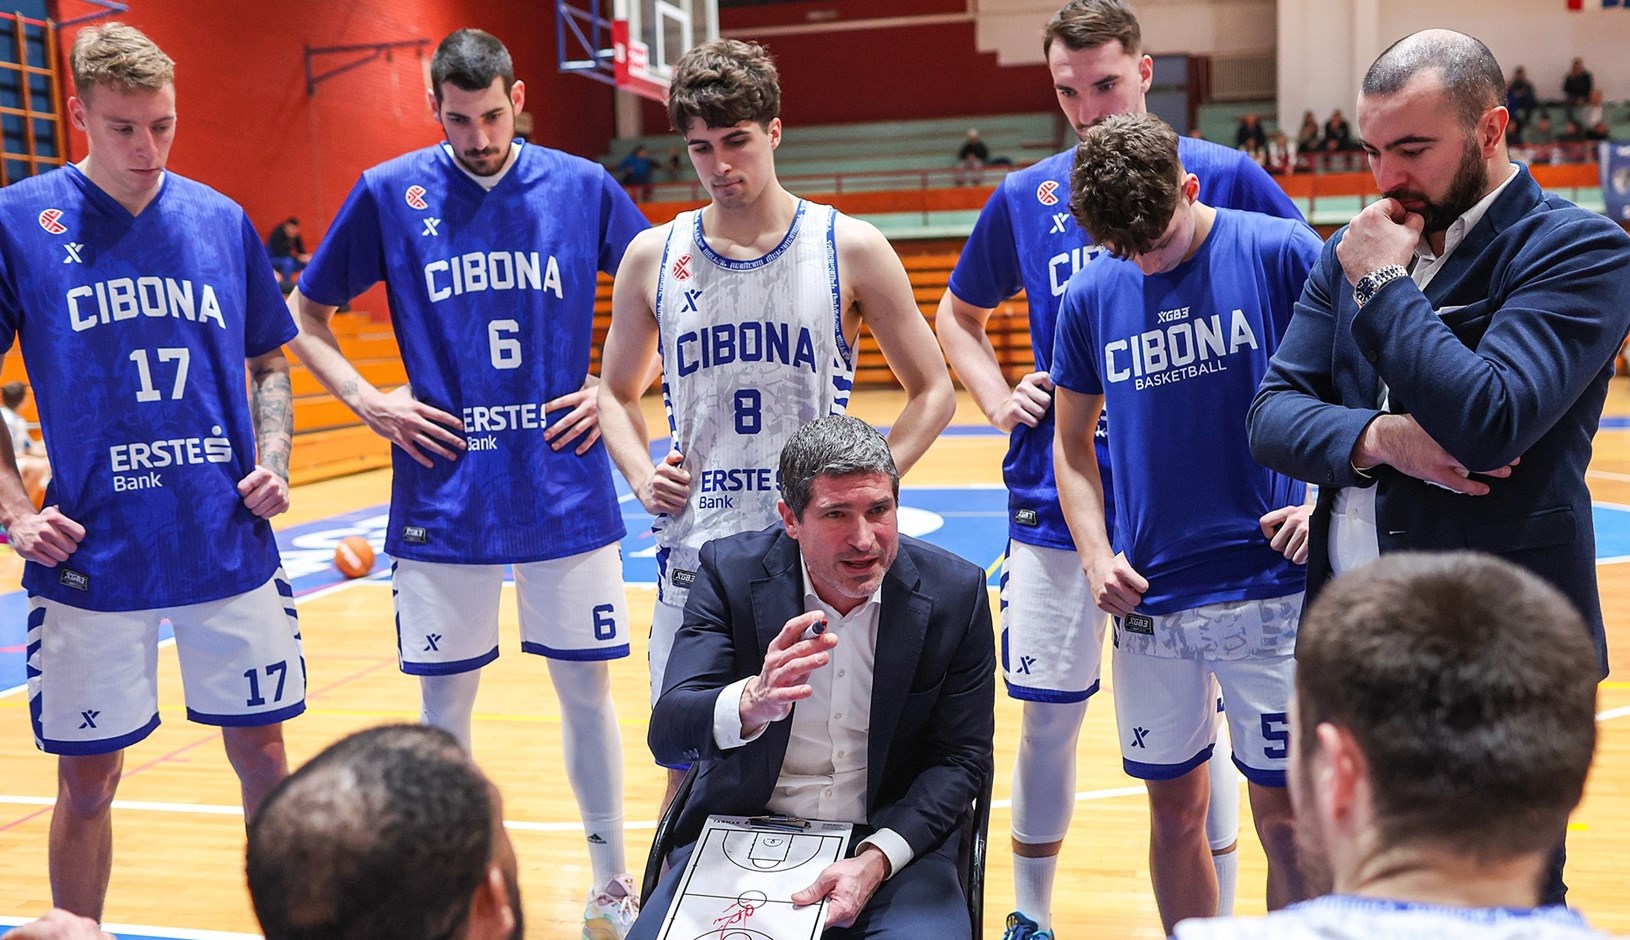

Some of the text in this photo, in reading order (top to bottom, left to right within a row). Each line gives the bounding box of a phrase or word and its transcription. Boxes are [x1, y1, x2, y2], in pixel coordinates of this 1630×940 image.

[424, 251, 563, 303] CIBONA
[67, 276, 226, 332] CIBONA
[1157, 306, 1190, 324] XGB3
[487, 319, 522, 369] 6
[676, 321, 817, 378] CIBONA
[1104, 309, 1258, 383] CIBONA
[129, 347, 190, 402] 17
[1135, 359, 1227, 391] BASKETBALL
[733, 389, 762, 435] 8
[114, 472, 162, 492] Bank
[699, 495, 733, 509] Bank
[701, 469, 772, 493] ERSTE
[592, 603, 617, 641] 6
[243, 660, 287, 707] 17
[1260, 712, 1290, 759] 5
